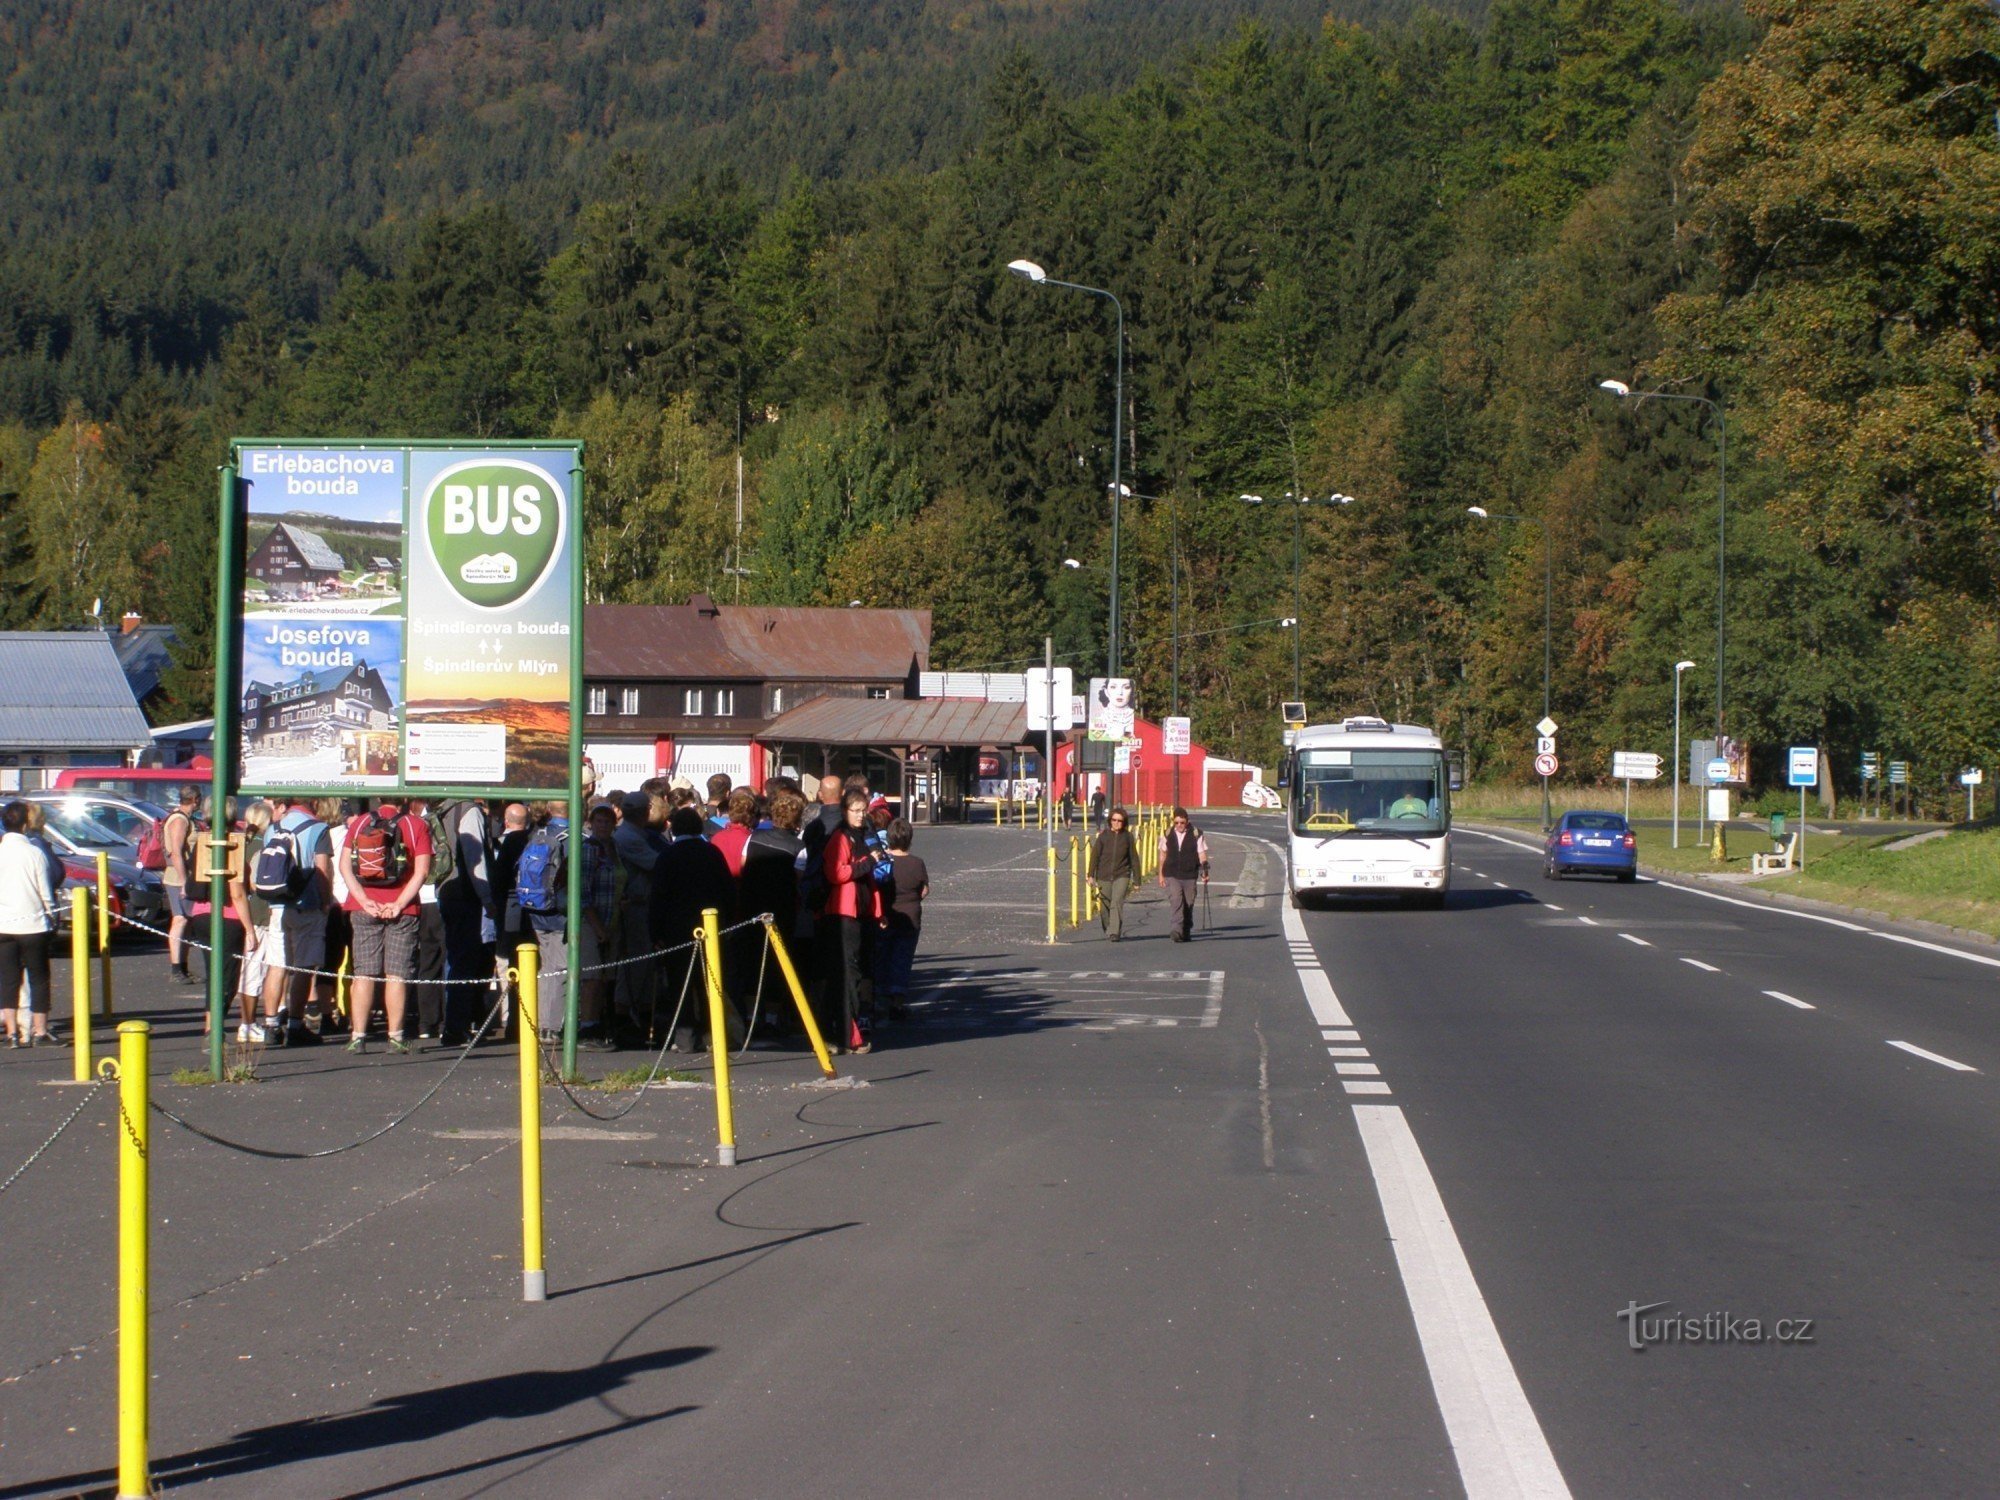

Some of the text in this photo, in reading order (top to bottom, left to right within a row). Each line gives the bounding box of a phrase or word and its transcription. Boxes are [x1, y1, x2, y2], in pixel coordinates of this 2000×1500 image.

[252, 454, 395, 474] Erlebachova
[287, 475, 359, 495] bouda
[443, 484, 542, 536] BUS
[264, 625, 370, 646] Josefova
[413, 617, 571, 637] Špindlerova bouda
[281, 646, 354, 667] bouda
[423, 656, 559, 676] Špindlerův Mlýn
